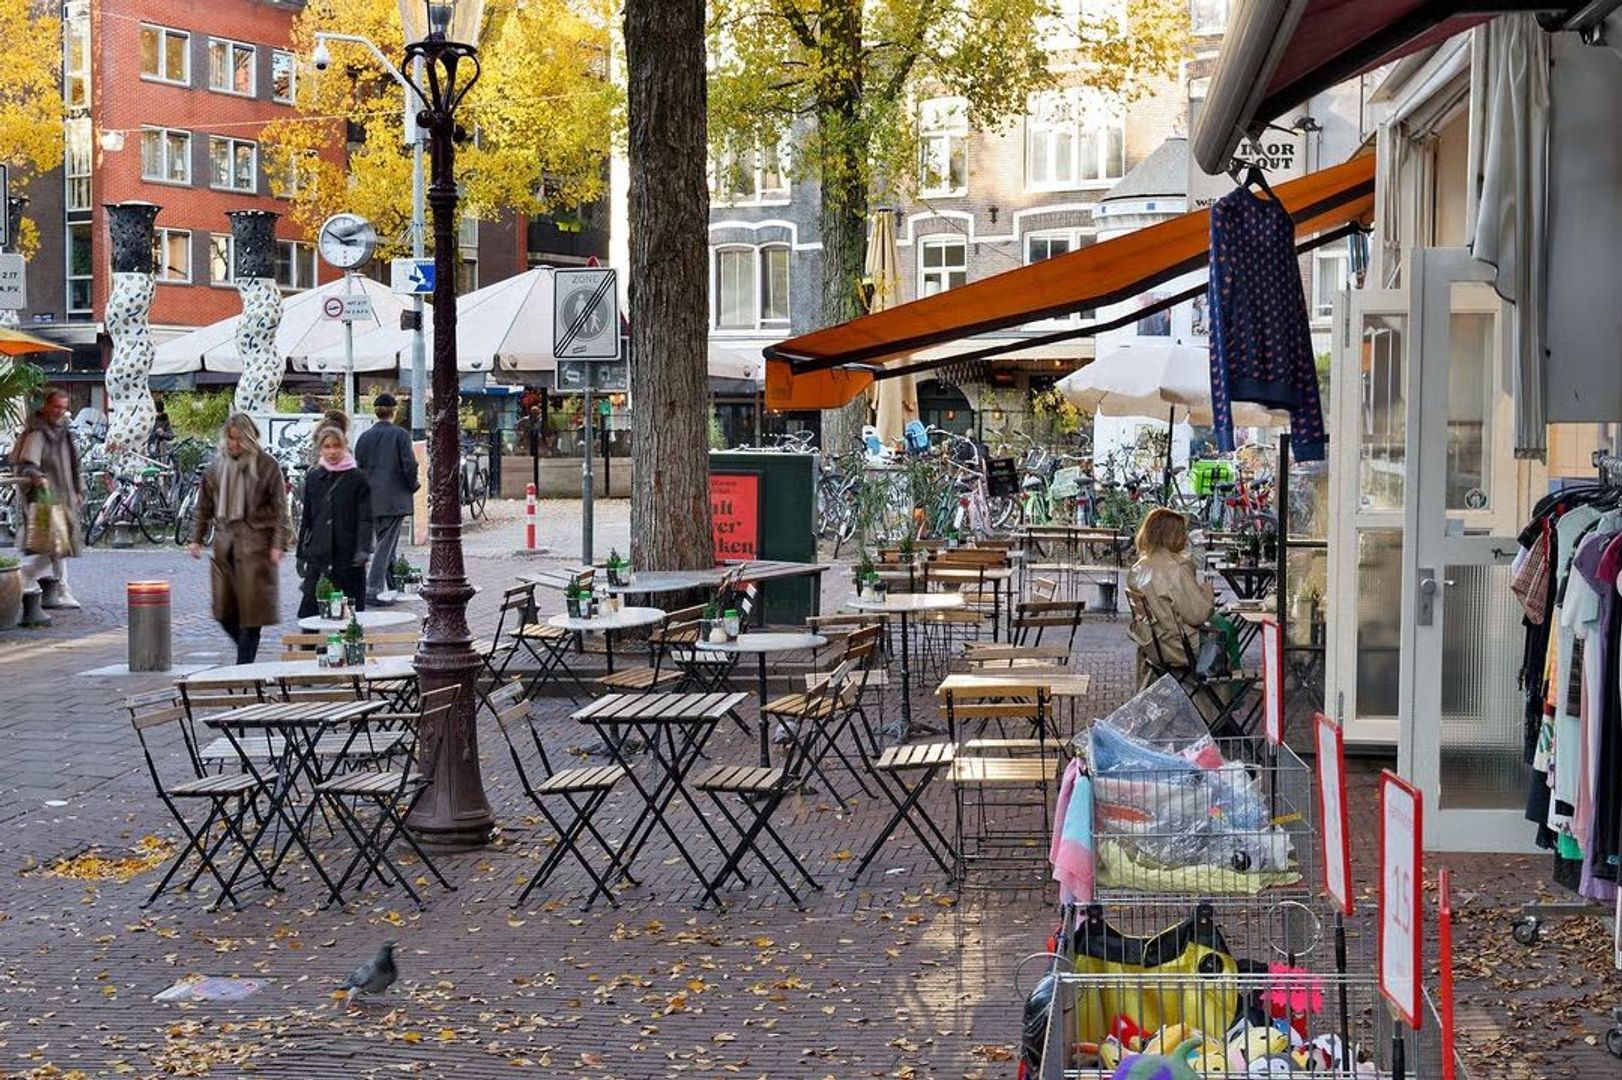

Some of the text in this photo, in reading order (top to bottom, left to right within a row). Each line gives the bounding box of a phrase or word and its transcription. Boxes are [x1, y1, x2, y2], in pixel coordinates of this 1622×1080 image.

[1267, 143, 1295, 156] OR
[1256, 157, 1293, 169] OUT
[571, 274, 600, 284] ZONE
